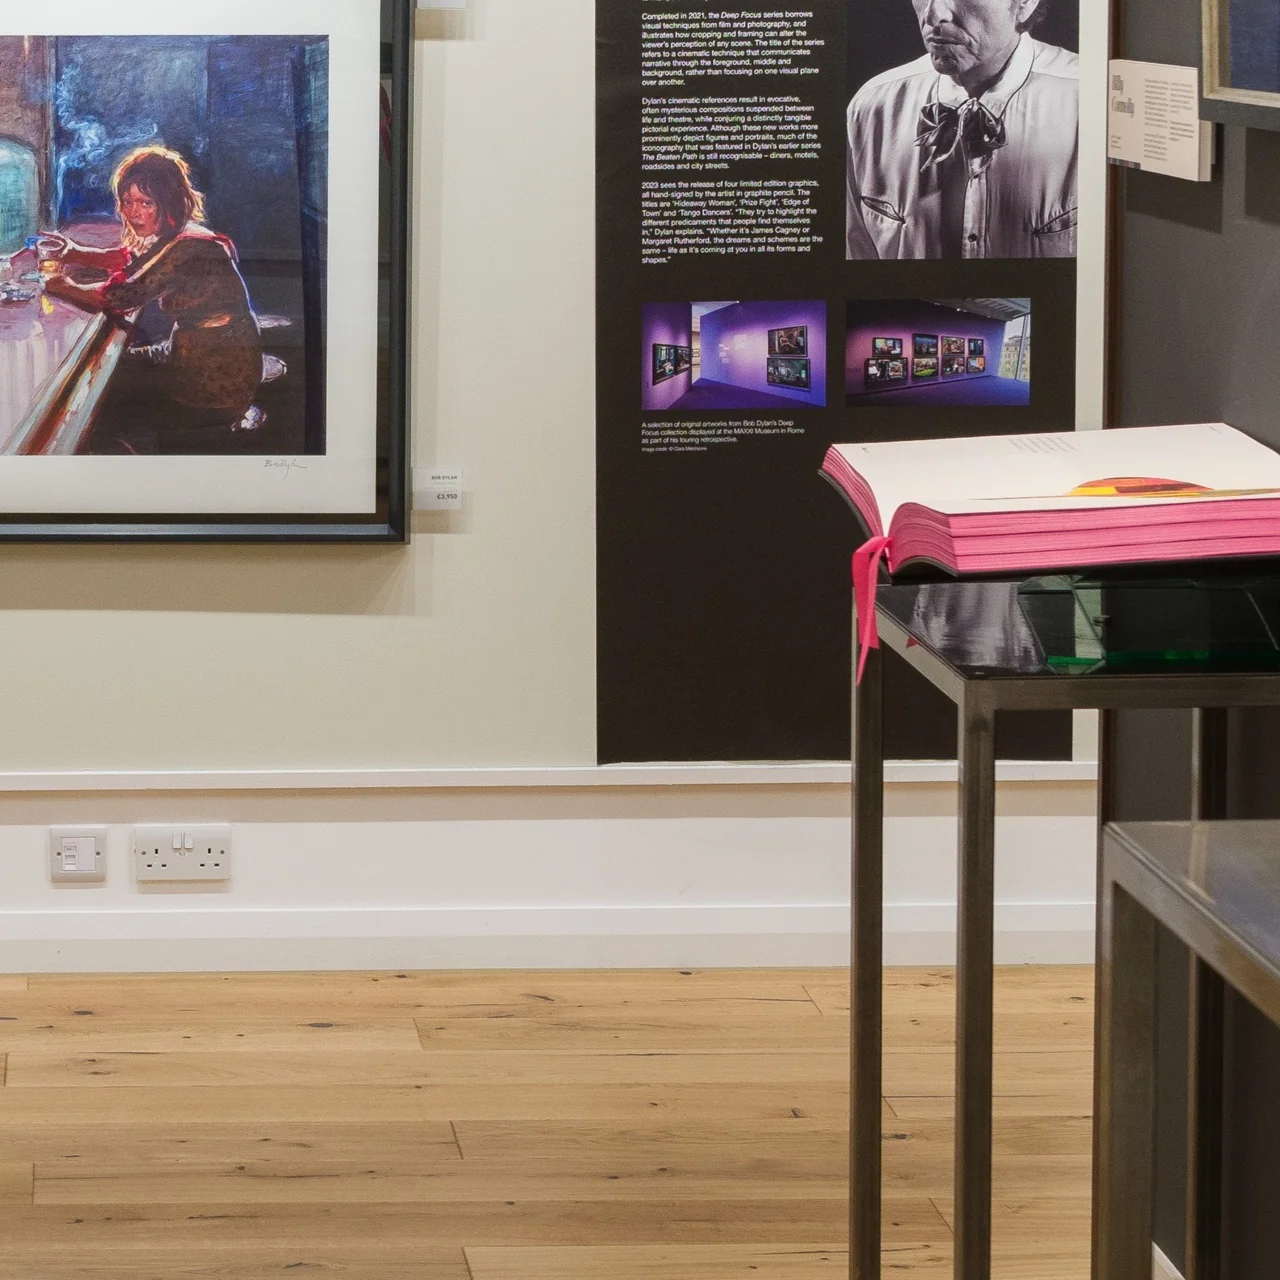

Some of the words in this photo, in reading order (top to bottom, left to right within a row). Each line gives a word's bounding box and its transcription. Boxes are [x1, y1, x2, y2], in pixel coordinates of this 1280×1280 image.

[641, 12, 680, 22] Completed
[720, 12, 740, 21] Deep
[740, 11, 762, 19] Focus
[763, 11, 784, 19] series
[785, 11, 813, 19] borrows
[668, 97, 701, 105] cinematic
[738, 96, 758, 104] result
[677, 181, 689, 189] the
[690, 181, 715, 189] release
[763, 180, 787, 188] edition
